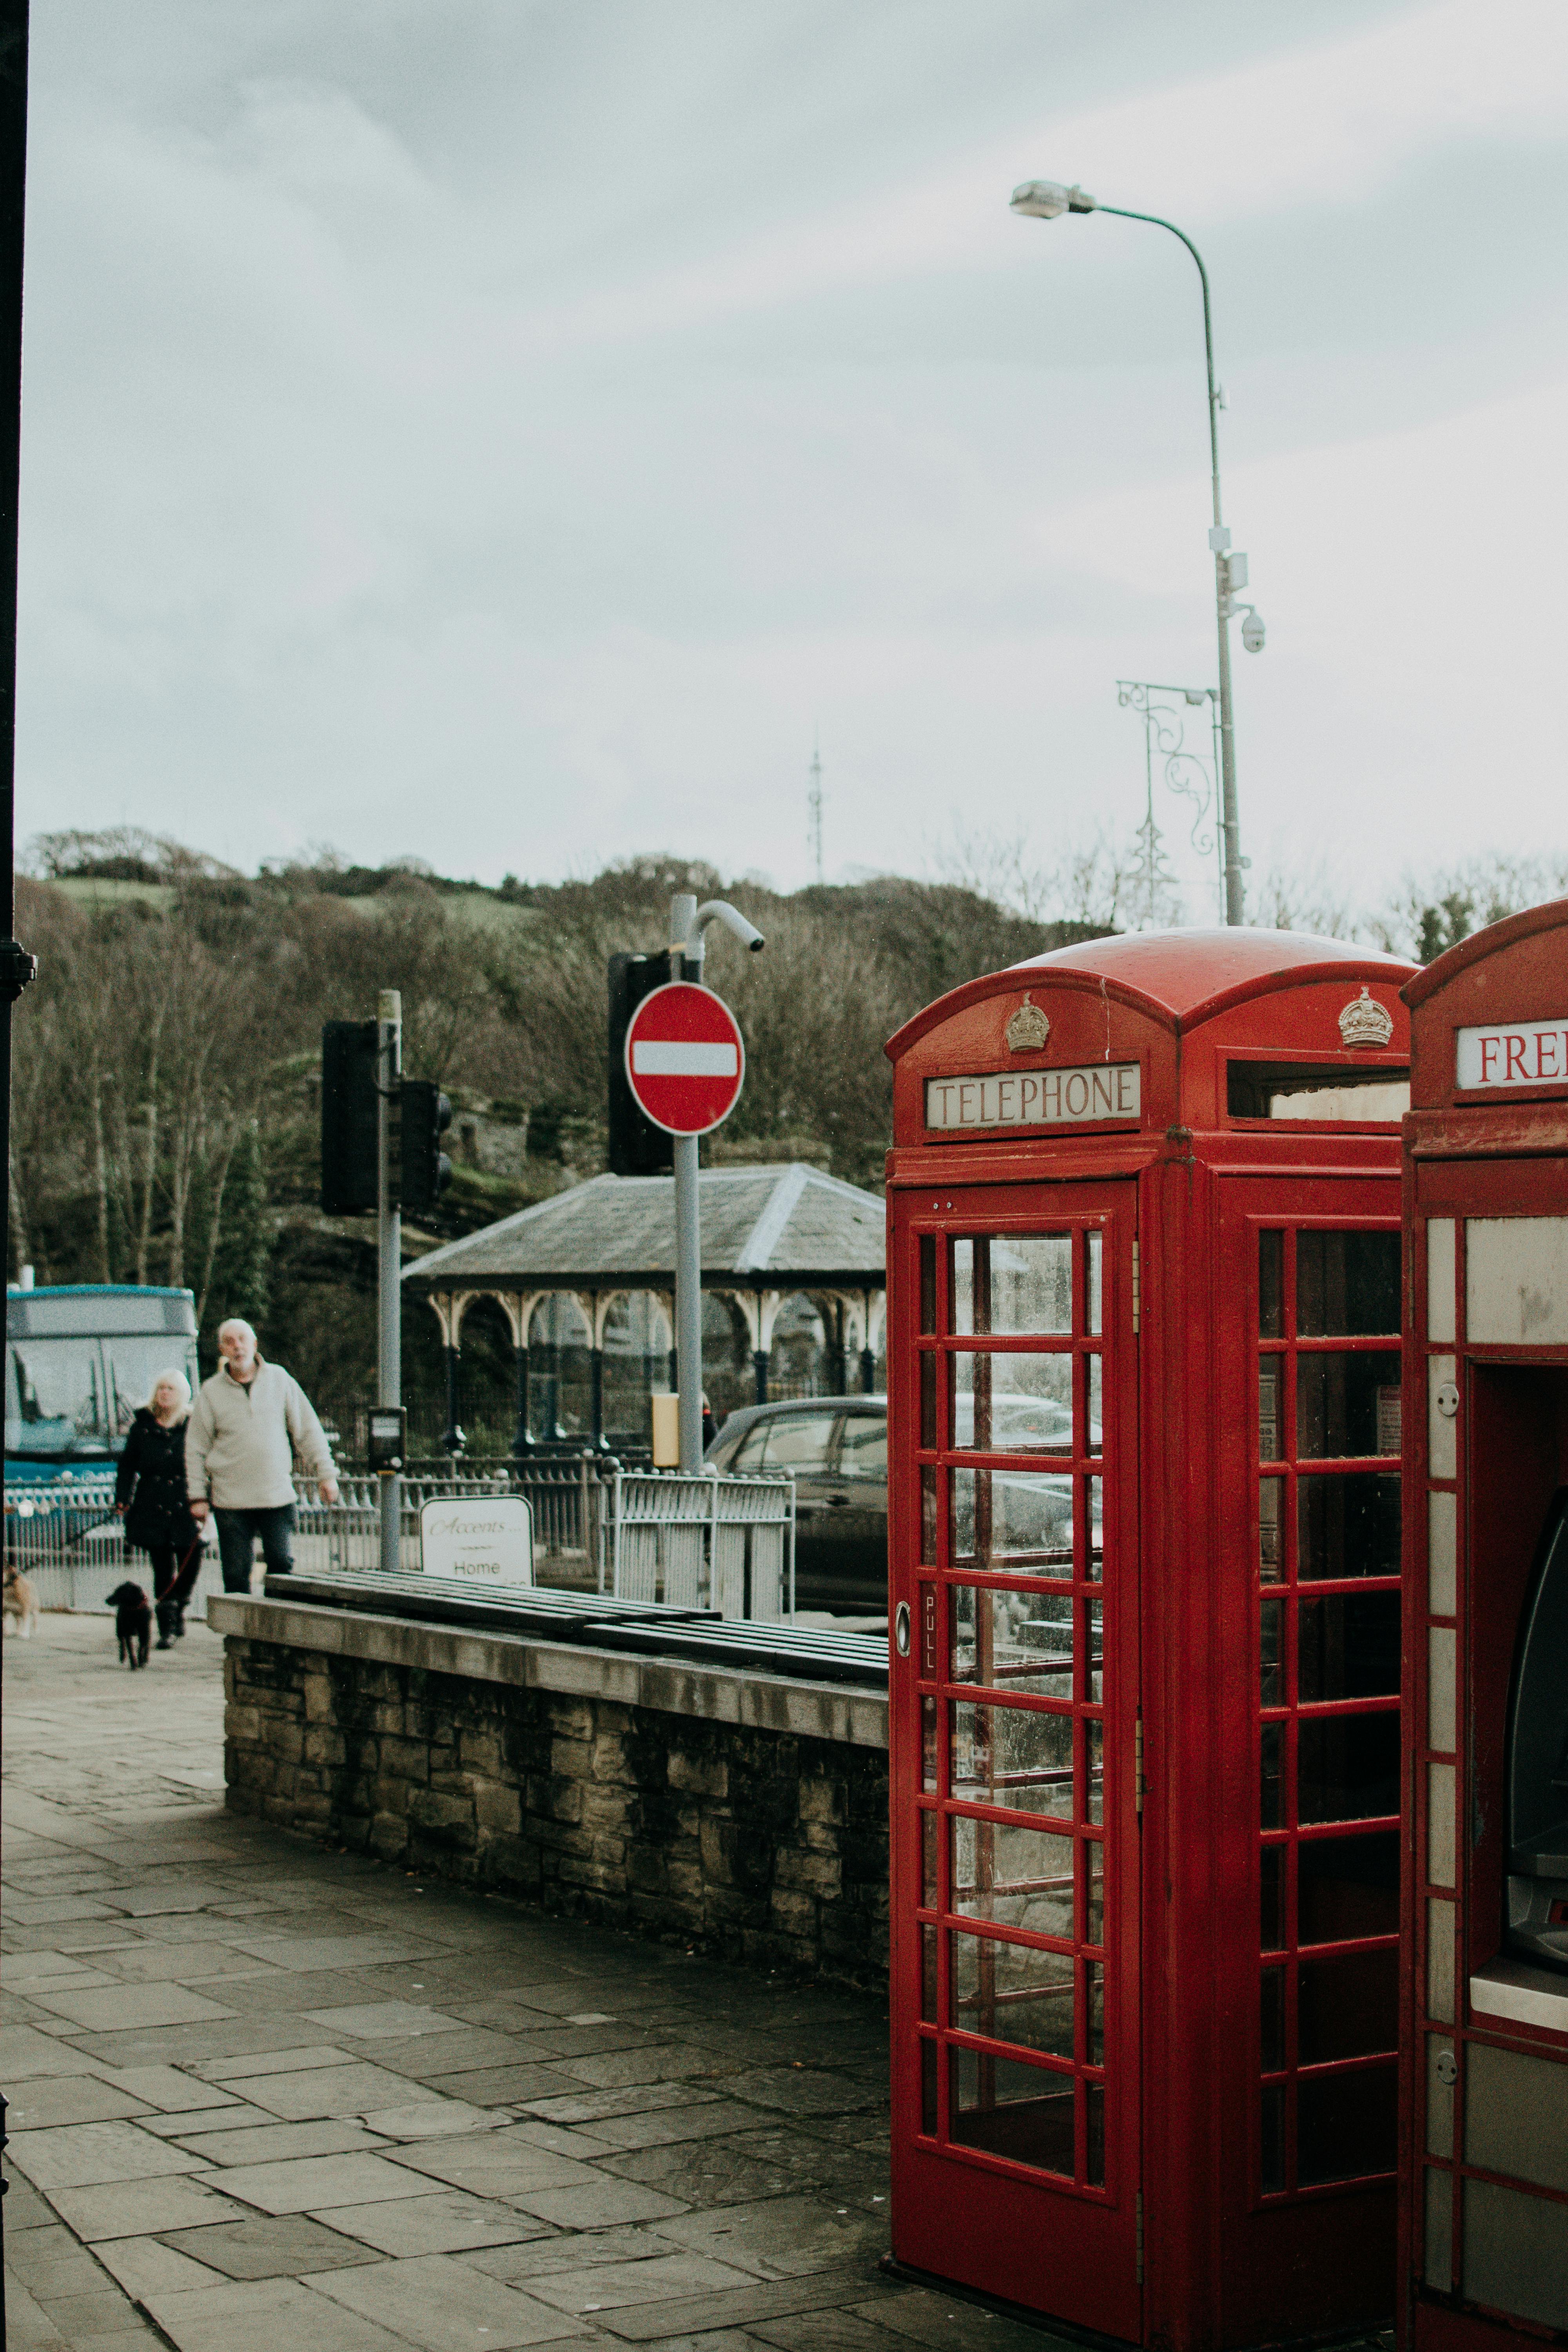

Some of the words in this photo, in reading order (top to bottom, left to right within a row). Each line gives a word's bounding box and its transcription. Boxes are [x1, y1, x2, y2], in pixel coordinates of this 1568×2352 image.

[1478, 1031, 1568, 1082] FRE
[936, 1068, 1134, 1125] TELEPHONE
[453, 1560, 501, 1576] Home
